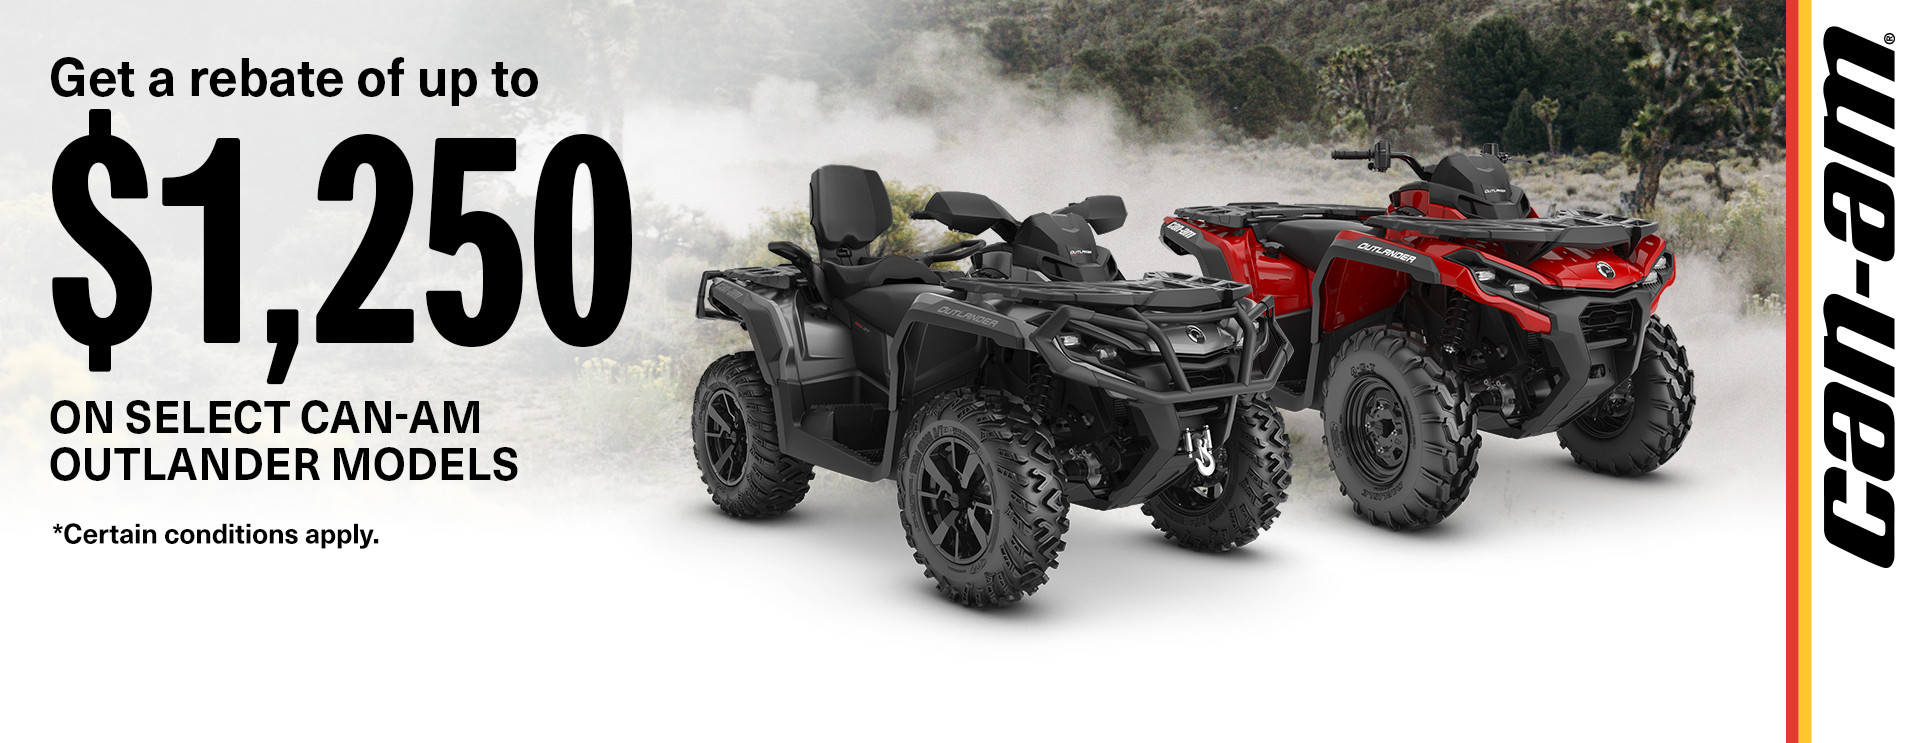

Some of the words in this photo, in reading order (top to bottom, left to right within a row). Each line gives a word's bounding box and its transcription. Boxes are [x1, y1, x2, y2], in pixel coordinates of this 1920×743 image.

[1167, 221, 1197, 239] can-am
[1357, 242, 1417, 263] OUTLANDER
[937, 306, 999, 328] OUTLANDER
